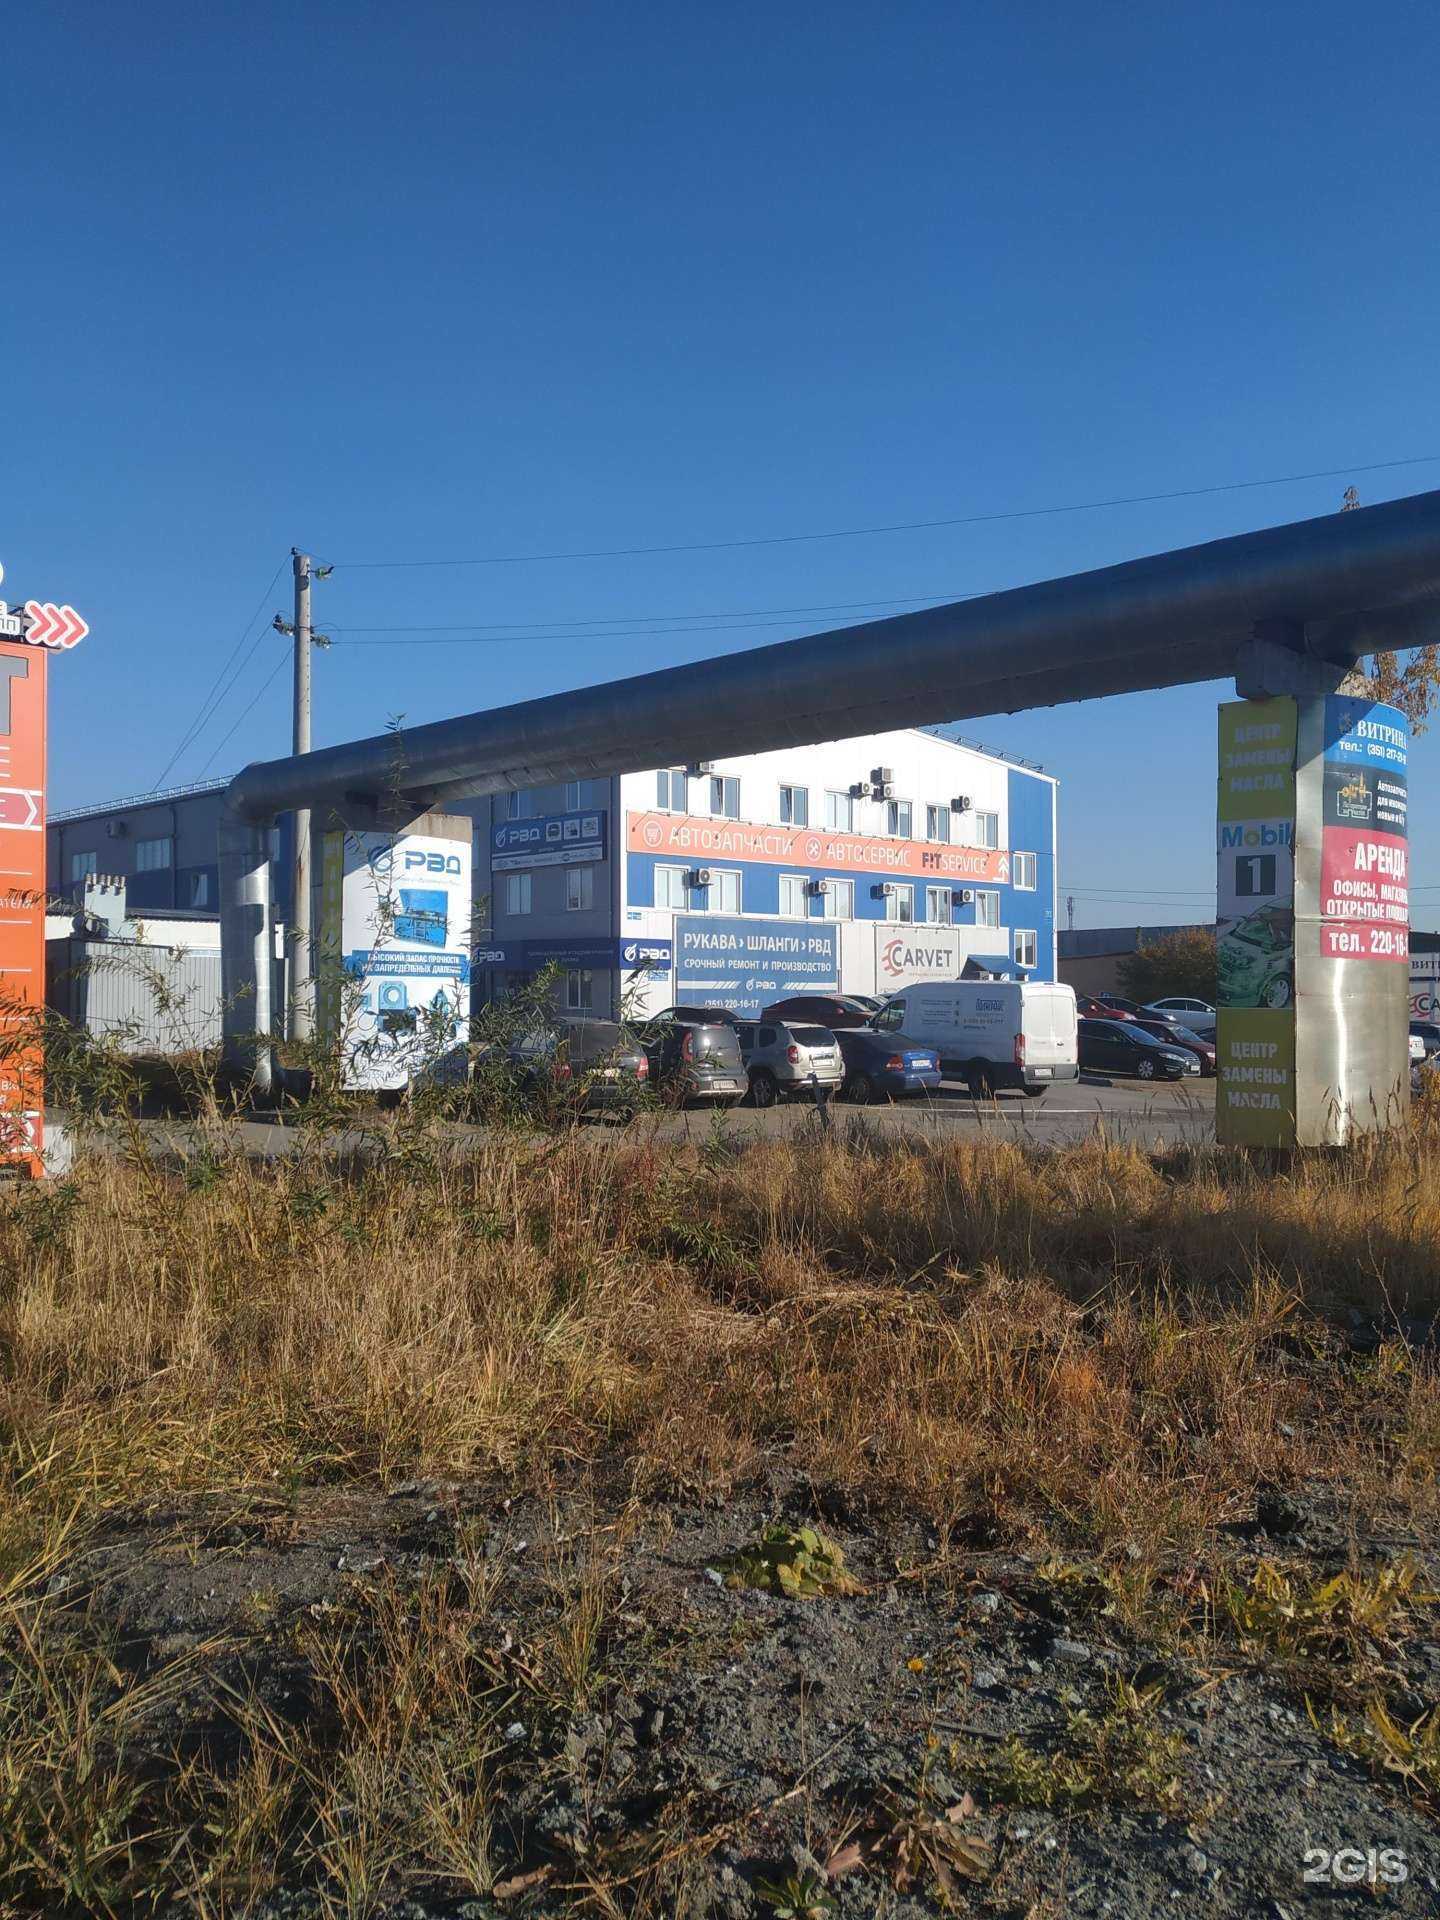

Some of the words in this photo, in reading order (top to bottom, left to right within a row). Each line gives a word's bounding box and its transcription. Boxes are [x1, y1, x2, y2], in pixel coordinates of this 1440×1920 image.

[668, 826, 793, 856] АВТОЗАПЧАСТИ
[1222, 822, 1291, 848] Mobil
[826, 842, 911, 867] АВТОСЕРВИС
[1354, 841, 1406, 881] АРЕНДА
[1247, 857, 1262, 894] 1
[1326, 899, 1384, 918] ОТКРЫТЫЕ
[684, 933, 737, 950] РУКАВА
[747, 936, 799, 952] ШЛАНГИ
[808, 939, 832, 957] РВД
[1329, 931, 1365, 952] тел.
[684, 956, 726, 969] СРОЧНЫЙ
[728, 958, 760, 970] РЕМОНТ
[762, 960, 769, 970] И
[771, 961, 832, 973] ПРОИЗВОДСТВО
[892, 946, 953, 968] CARVET
[1231, 1042, 1278, 1060] ЦЕНТР
[1222, 1066, 1287, 1085] ЗАМЕНЫ
[1227, 1090, 1281, 1110] МАСЛА
